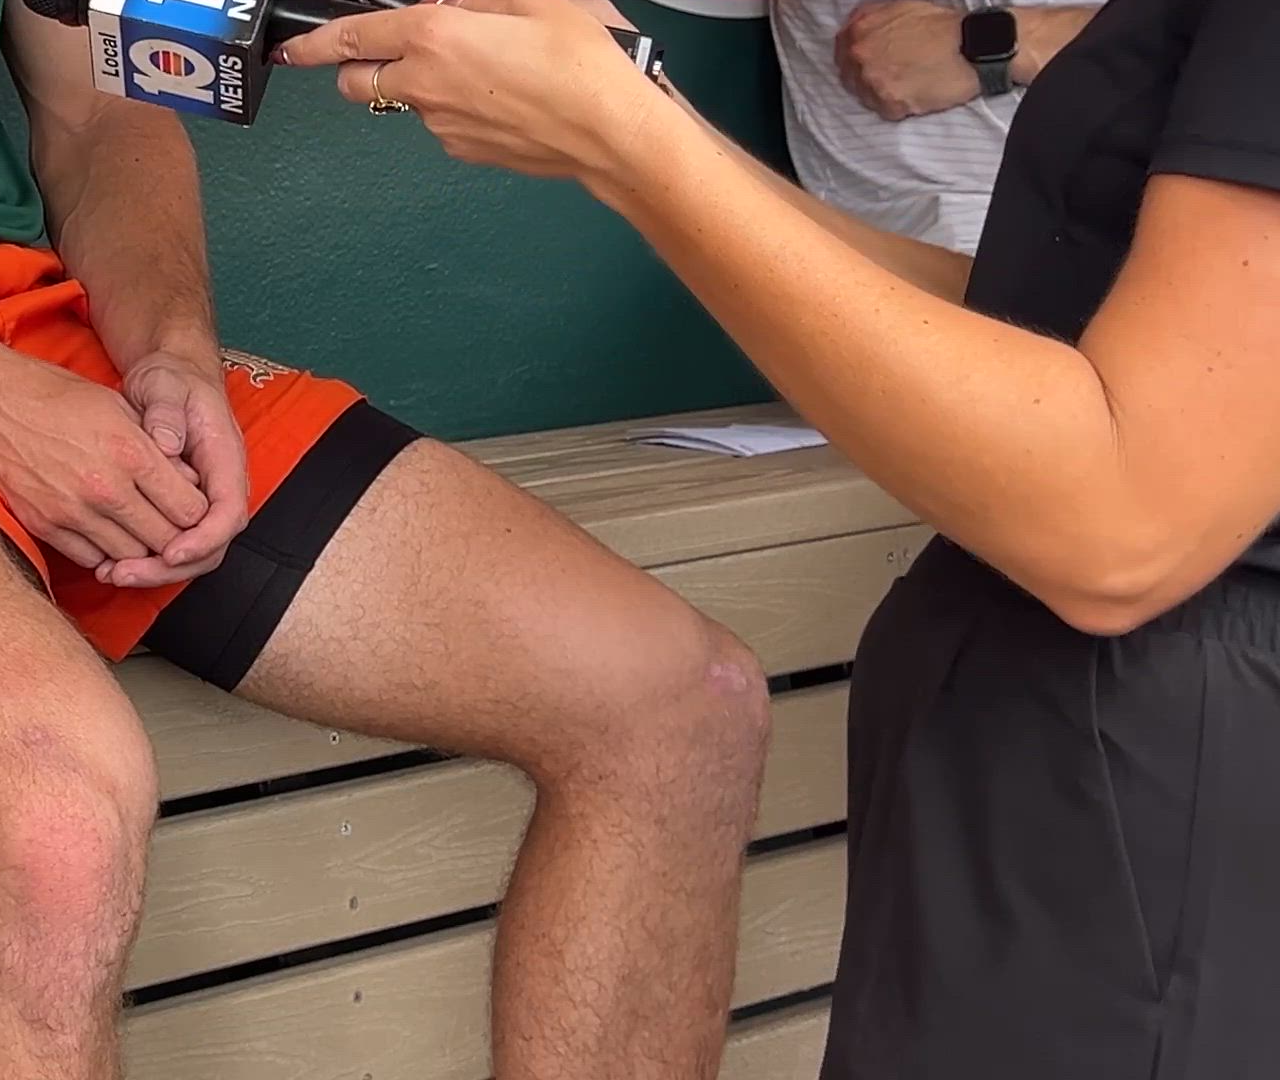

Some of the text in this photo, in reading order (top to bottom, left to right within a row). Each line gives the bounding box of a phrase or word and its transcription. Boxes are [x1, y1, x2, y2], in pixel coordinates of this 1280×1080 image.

[101, 32, 120, 78] Local
[128, 38, 216, 105] 10
[220, 54, 243, 114] NEWS
